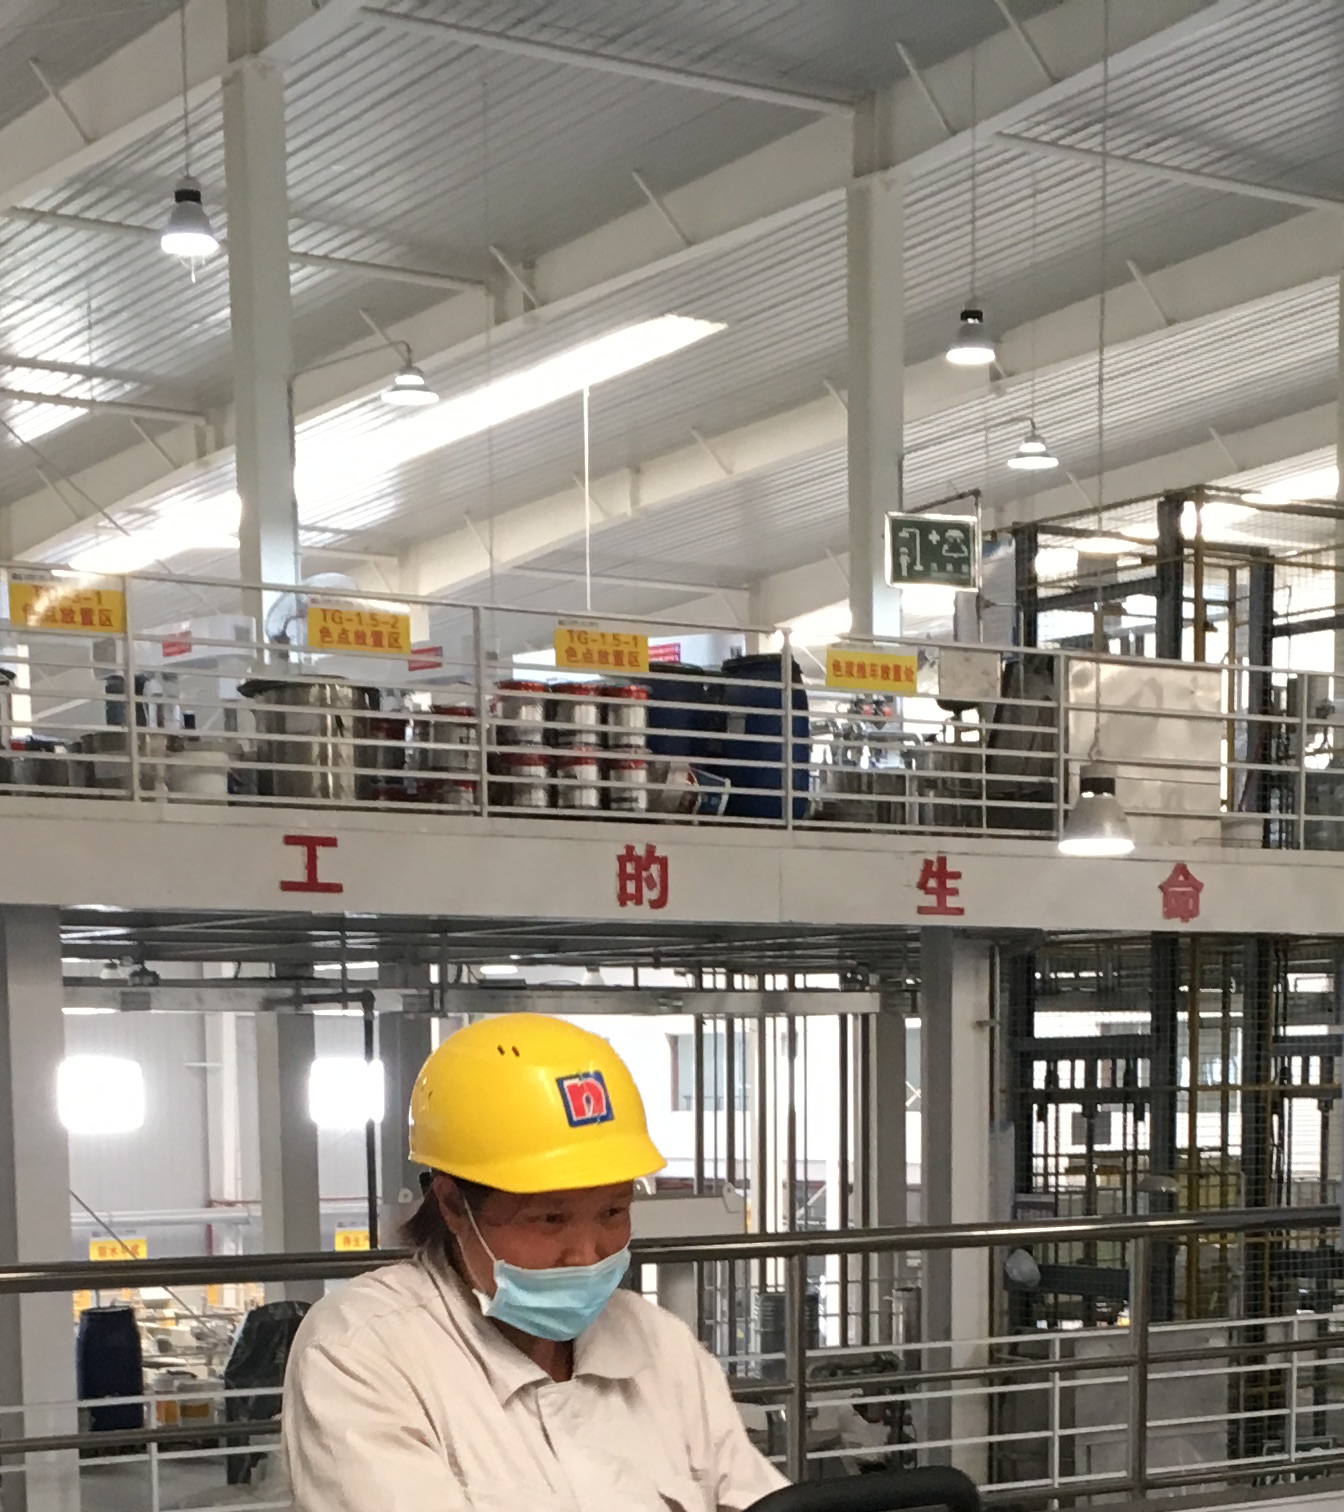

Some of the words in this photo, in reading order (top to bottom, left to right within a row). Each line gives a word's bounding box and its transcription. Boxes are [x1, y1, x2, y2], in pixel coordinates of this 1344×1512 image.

[318, 626, 403, 649] 色点放置区
[564, 646, 641, 668] 色点放置区
[279, 834, 344, 894] 工
[617, 843, 670, 910] 的
[916, 855, 965, 917] 生
[1158, 862, 1205, 923] 命
